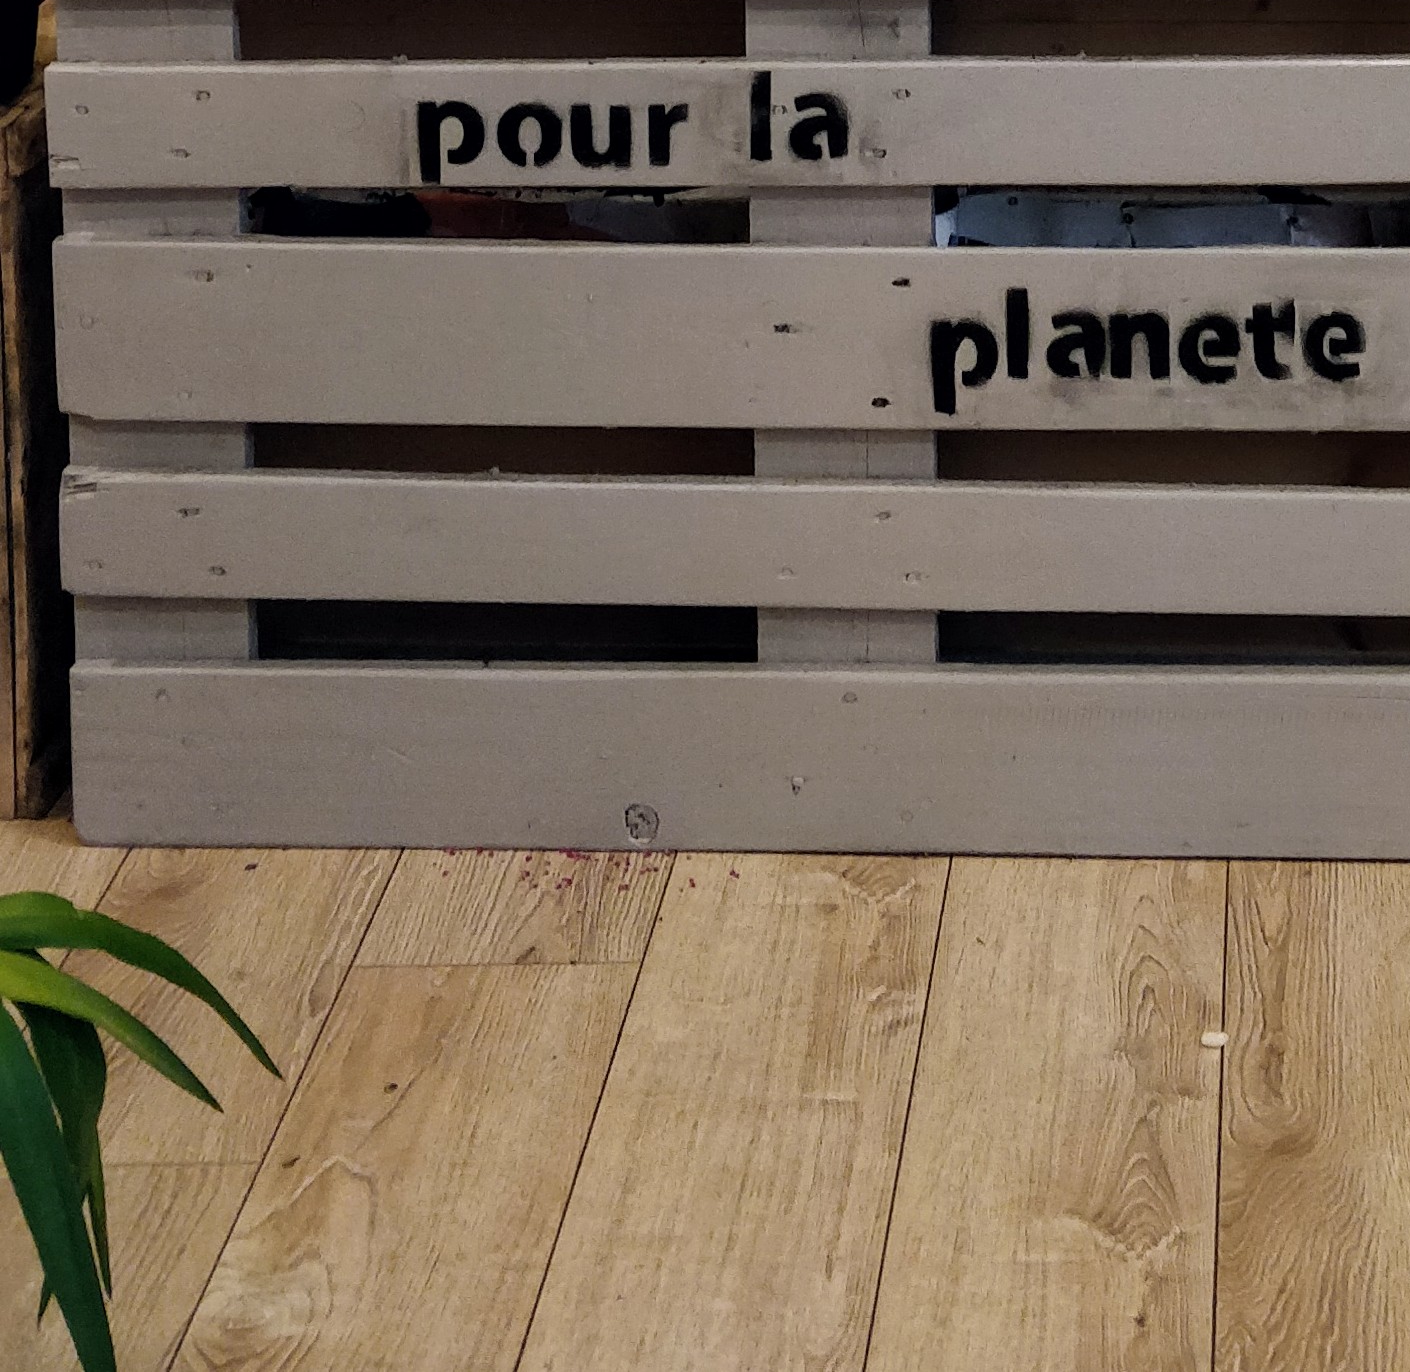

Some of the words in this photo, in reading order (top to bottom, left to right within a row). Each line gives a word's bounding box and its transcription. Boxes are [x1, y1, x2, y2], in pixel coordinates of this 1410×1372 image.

[415, 96, 691, 184] pour
[749, 71, 853, 161] la
[929, 288, 1367, 416] planete
